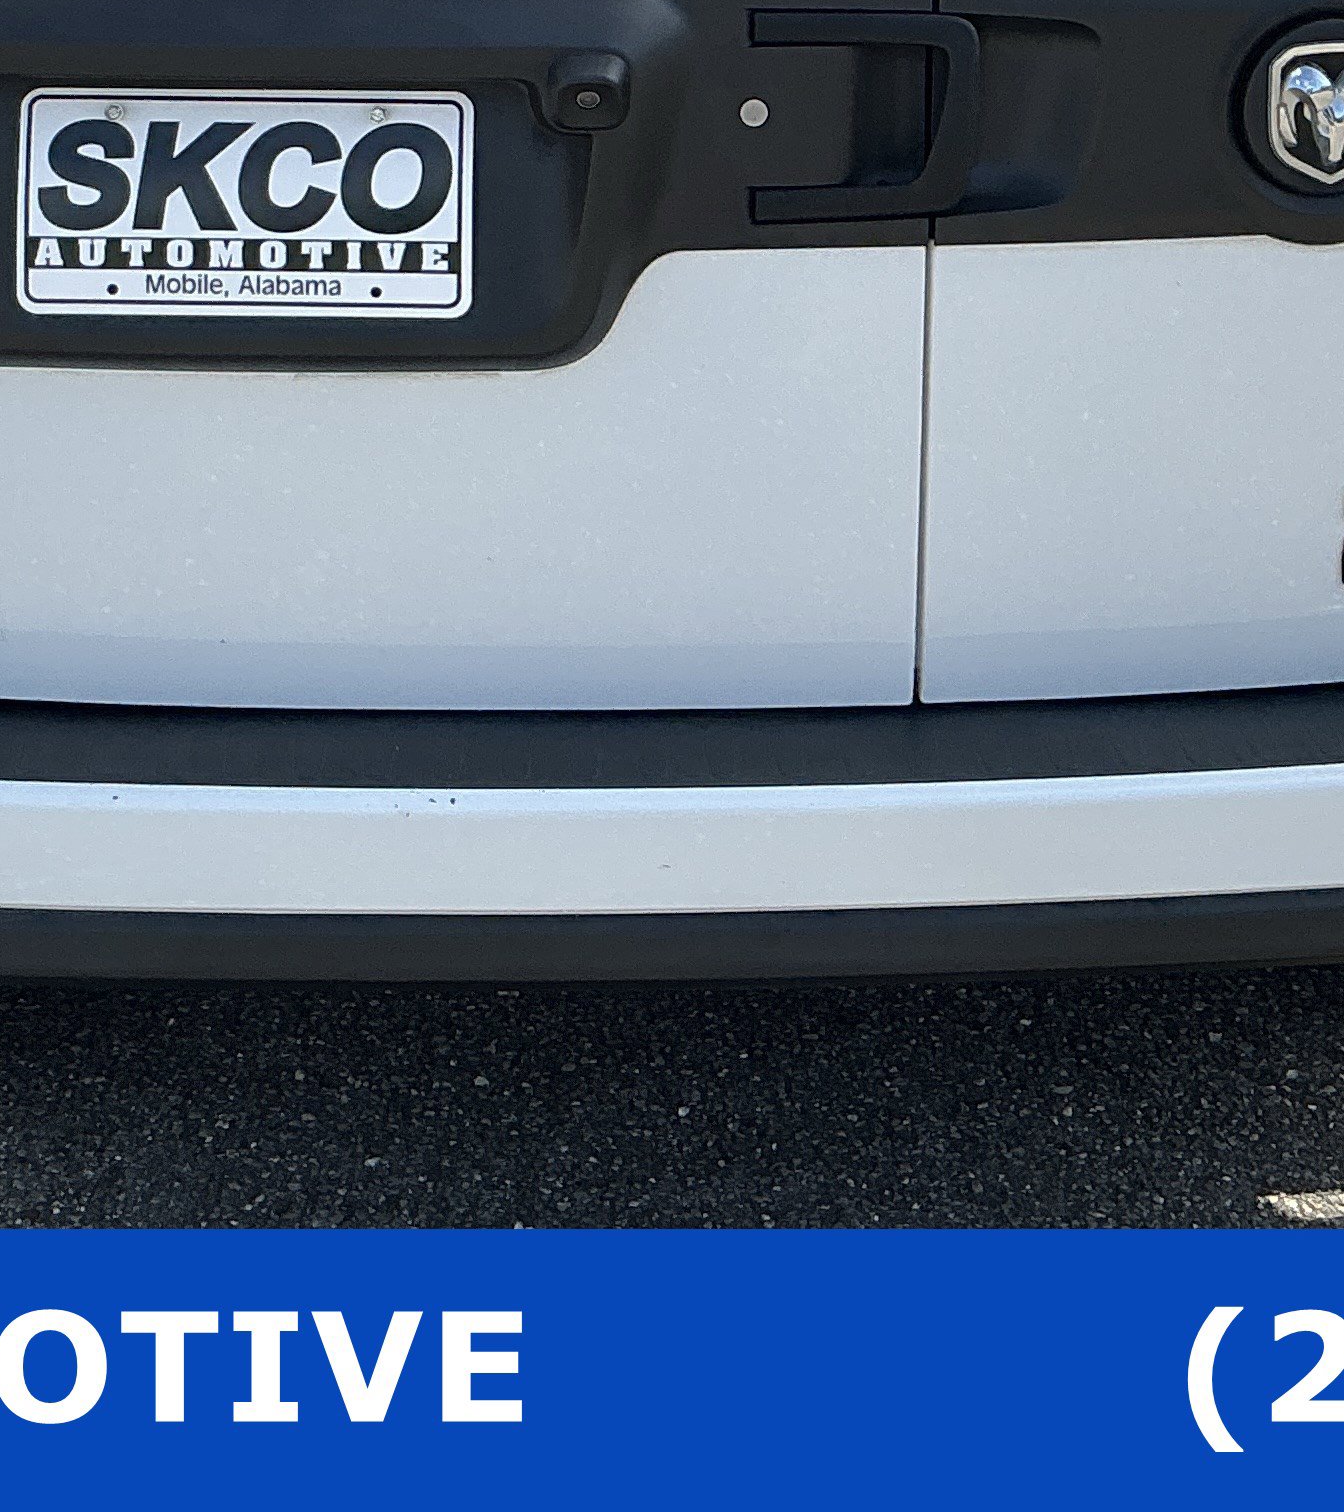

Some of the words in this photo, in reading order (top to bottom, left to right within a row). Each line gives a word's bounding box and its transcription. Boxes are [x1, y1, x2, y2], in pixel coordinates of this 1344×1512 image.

[38, 119, 453, 234] SKCO
[34, 238, 450, 271] AUTOMOTIVE
[145, 274, 229, 297] Mobile,
[238, 275, 341, 297] Alabama
